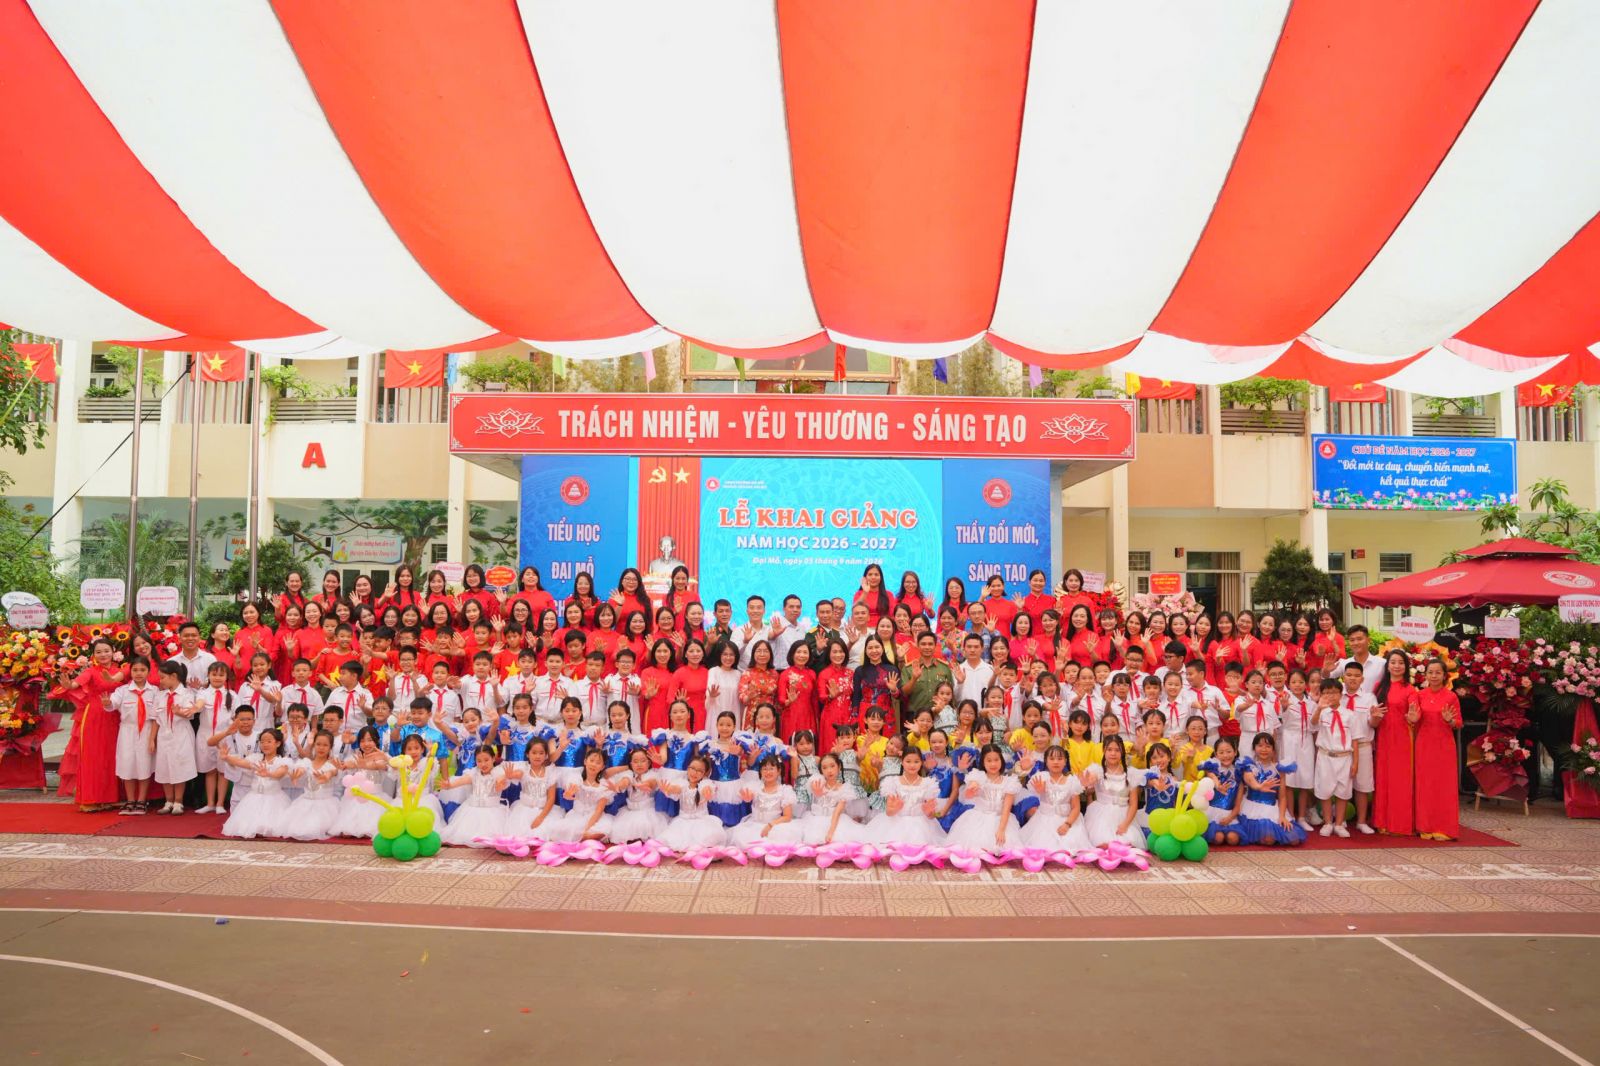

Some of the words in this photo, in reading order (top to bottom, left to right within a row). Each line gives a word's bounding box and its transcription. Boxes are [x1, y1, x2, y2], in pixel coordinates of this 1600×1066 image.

[558, 404, 633, 439] TRÁCH
[642, 405, 719, 443] NHIỆM
[743, 405, 786, 439] YÊU
[794, 408, 888, 441] THƯƠNG
[912, 408, 976, 442] SÁNG
[983, 414, 1027, 447] TẠO
[301, 442, 327, 469] A
[1351, 443, 1371, 455] CHỦ
[1386, 444, 1409, 455] NĂM
[1410, 447, 1429, 457] HỌC
[1358, 460, 1374, 470] mới
[1375, 461, 1384, 470] tư
[1385, 461, 1403, 474] duy,
[1405, 460, 1433, 474] chuyển
[1434, 461, 1451, 472] biến
[1452, 462, 1475, 473] mạnh
[1380, 475, 1393, 486] kết
[1411, 476, 1429, 487] thực
[719, 499, 751, 528] LỄ
[756, 508, 825, 528] KHAI
[830, 502, 918, 529] GIẢNG
[547, 517, 573, 542] TIỂU
[576, 523, 600, 546] HỌC
[736, 534, 773, 549] NĂM
[776, 536, 810, 552] HỌC
[812, 537, 849, 550] 2026
[859, 537, 897, 550] 2027
[955, 519, 986, 544] THẦY
[988, 520, 1009, 544] ĐỔI
[1012, 521, 1039, 547] MỚI,
[551, 561, 572, 583] ĐẠI
[783, 557, 802, 566] ngày
[815, 557, 838, 566] tháng
[969, 561, 1001, 582] SÁNG
[1004, 564, 1027, 585] TẠO
